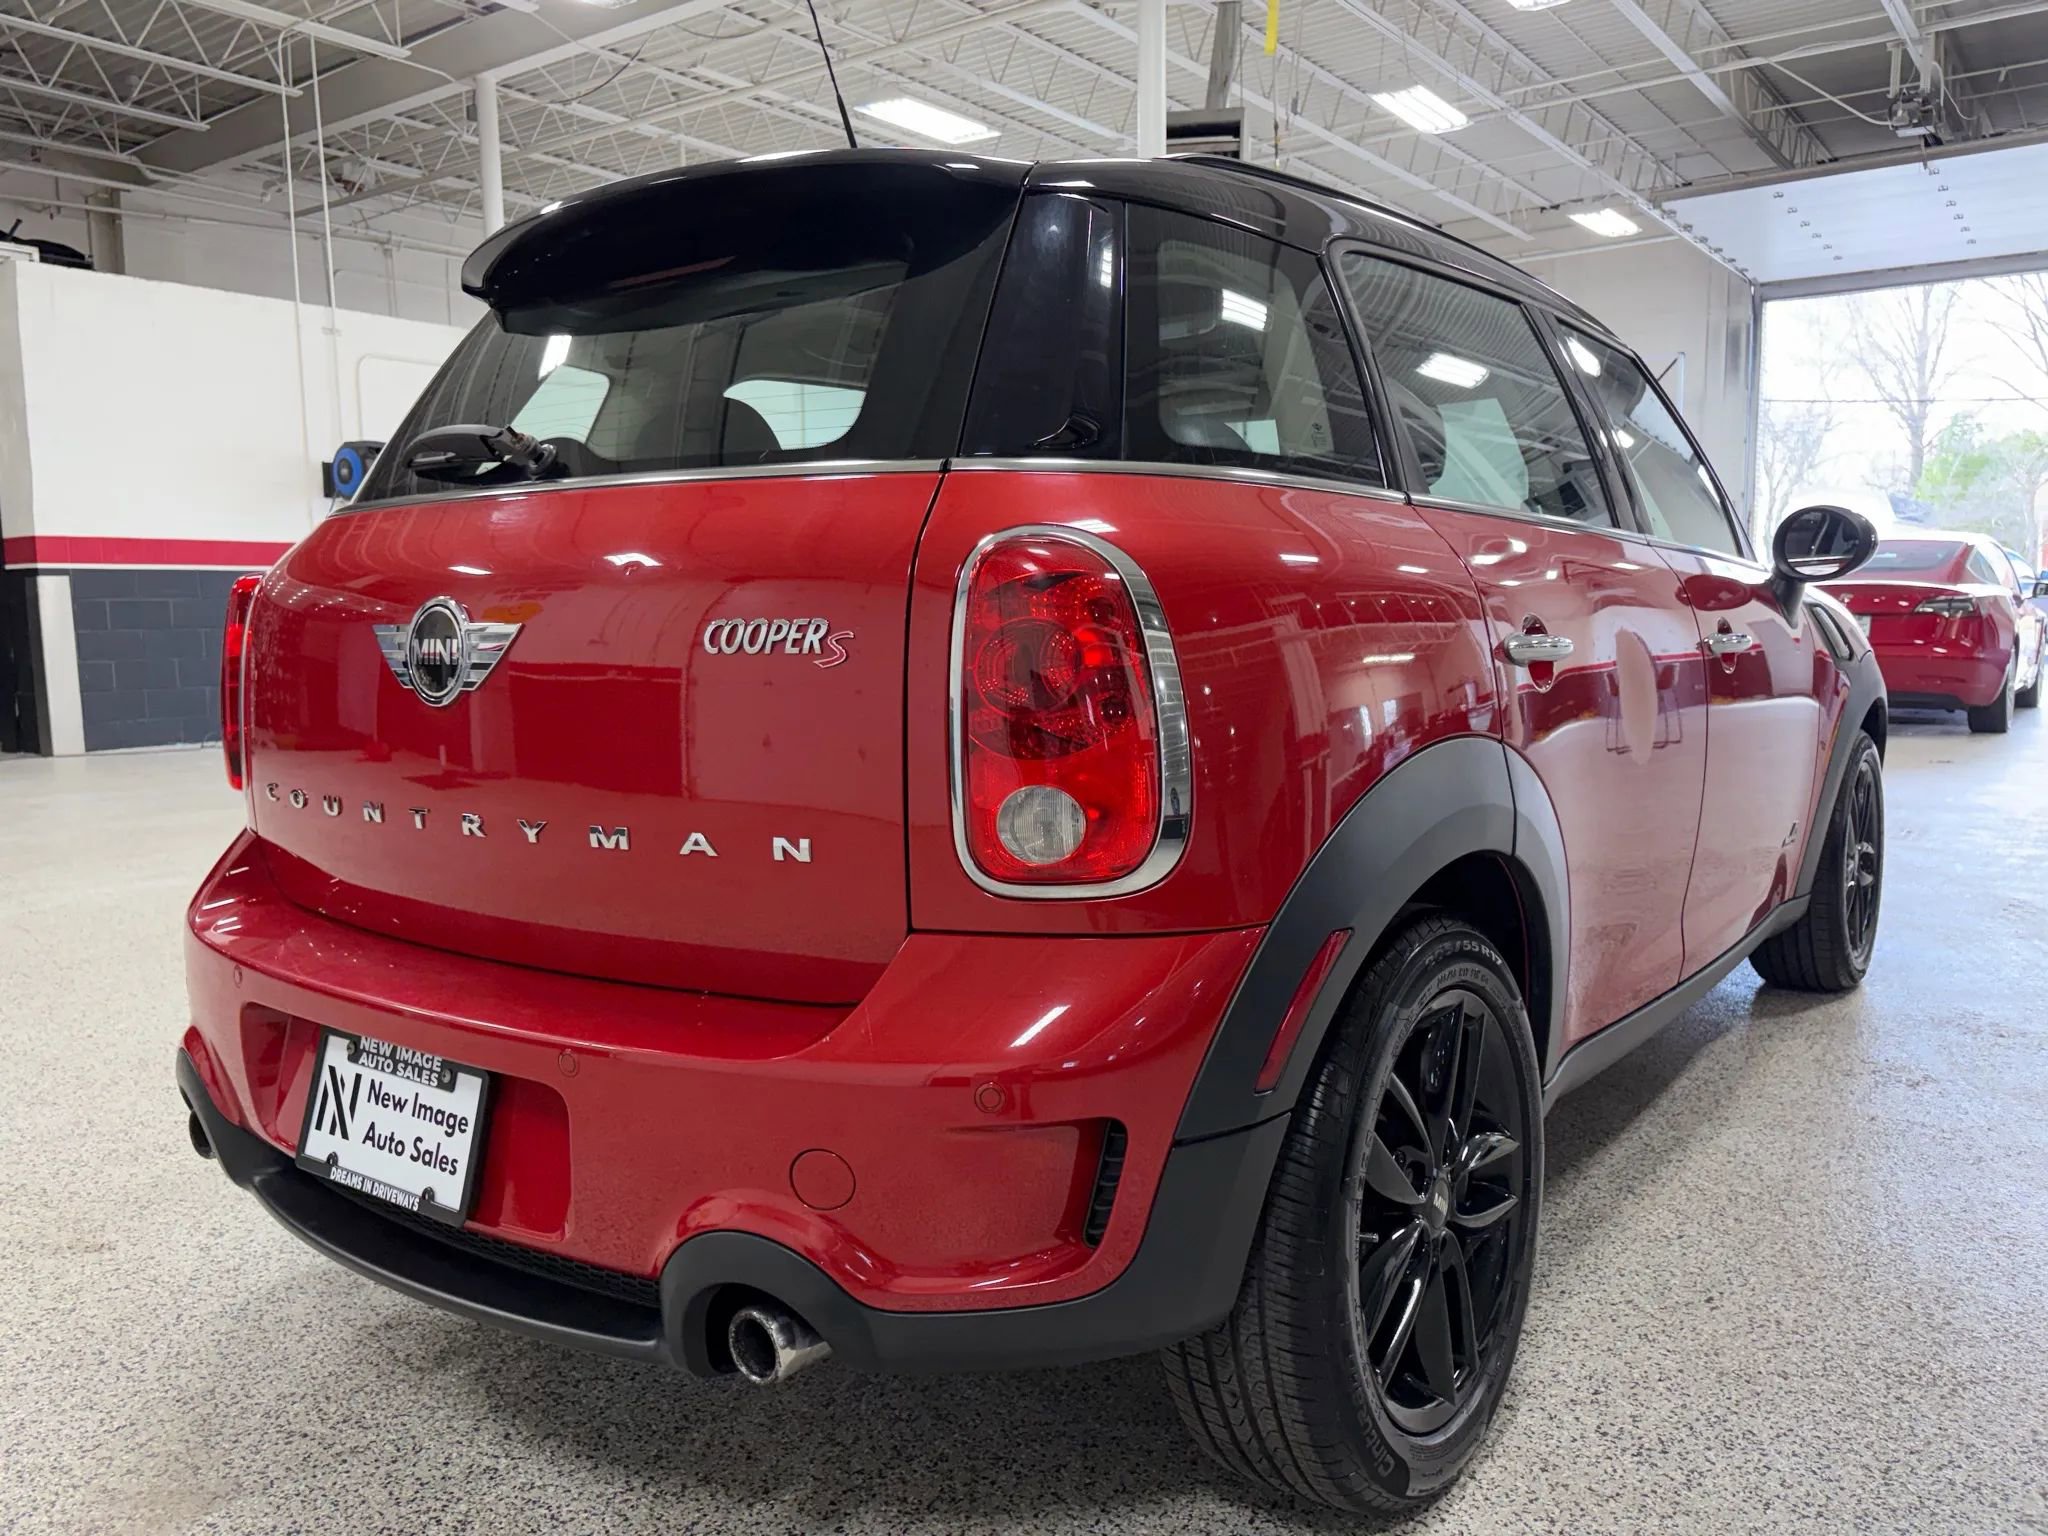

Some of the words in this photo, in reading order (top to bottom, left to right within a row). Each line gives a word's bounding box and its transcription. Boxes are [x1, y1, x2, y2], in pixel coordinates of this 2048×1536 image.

[412, 637, 459, 665] MINI
[703, 618, 830, 655] COOPER
[812, 630, 855, 669] S
[265, 782, 813, 863] COUNTRYMAN
[358, 1051, 394, 1074] AUTO
[396, 1062, 439, 1088] SALES
[359, 1035, 394, 1058] NEW
[395, 1045, 443, 1073] IMAGE
[366, 1078, 409, 1114] New
[411, 1091, 469, 1138] Image
[361, 1121, 406, 1158] Auto
[409, 1136, 459, 1176] Sales
[329, 1166, 363, 1191] DREAMS
[361, 1178, 374, 1195] IN
[372, 1181, 421, 1212] DRIVEWAYS
